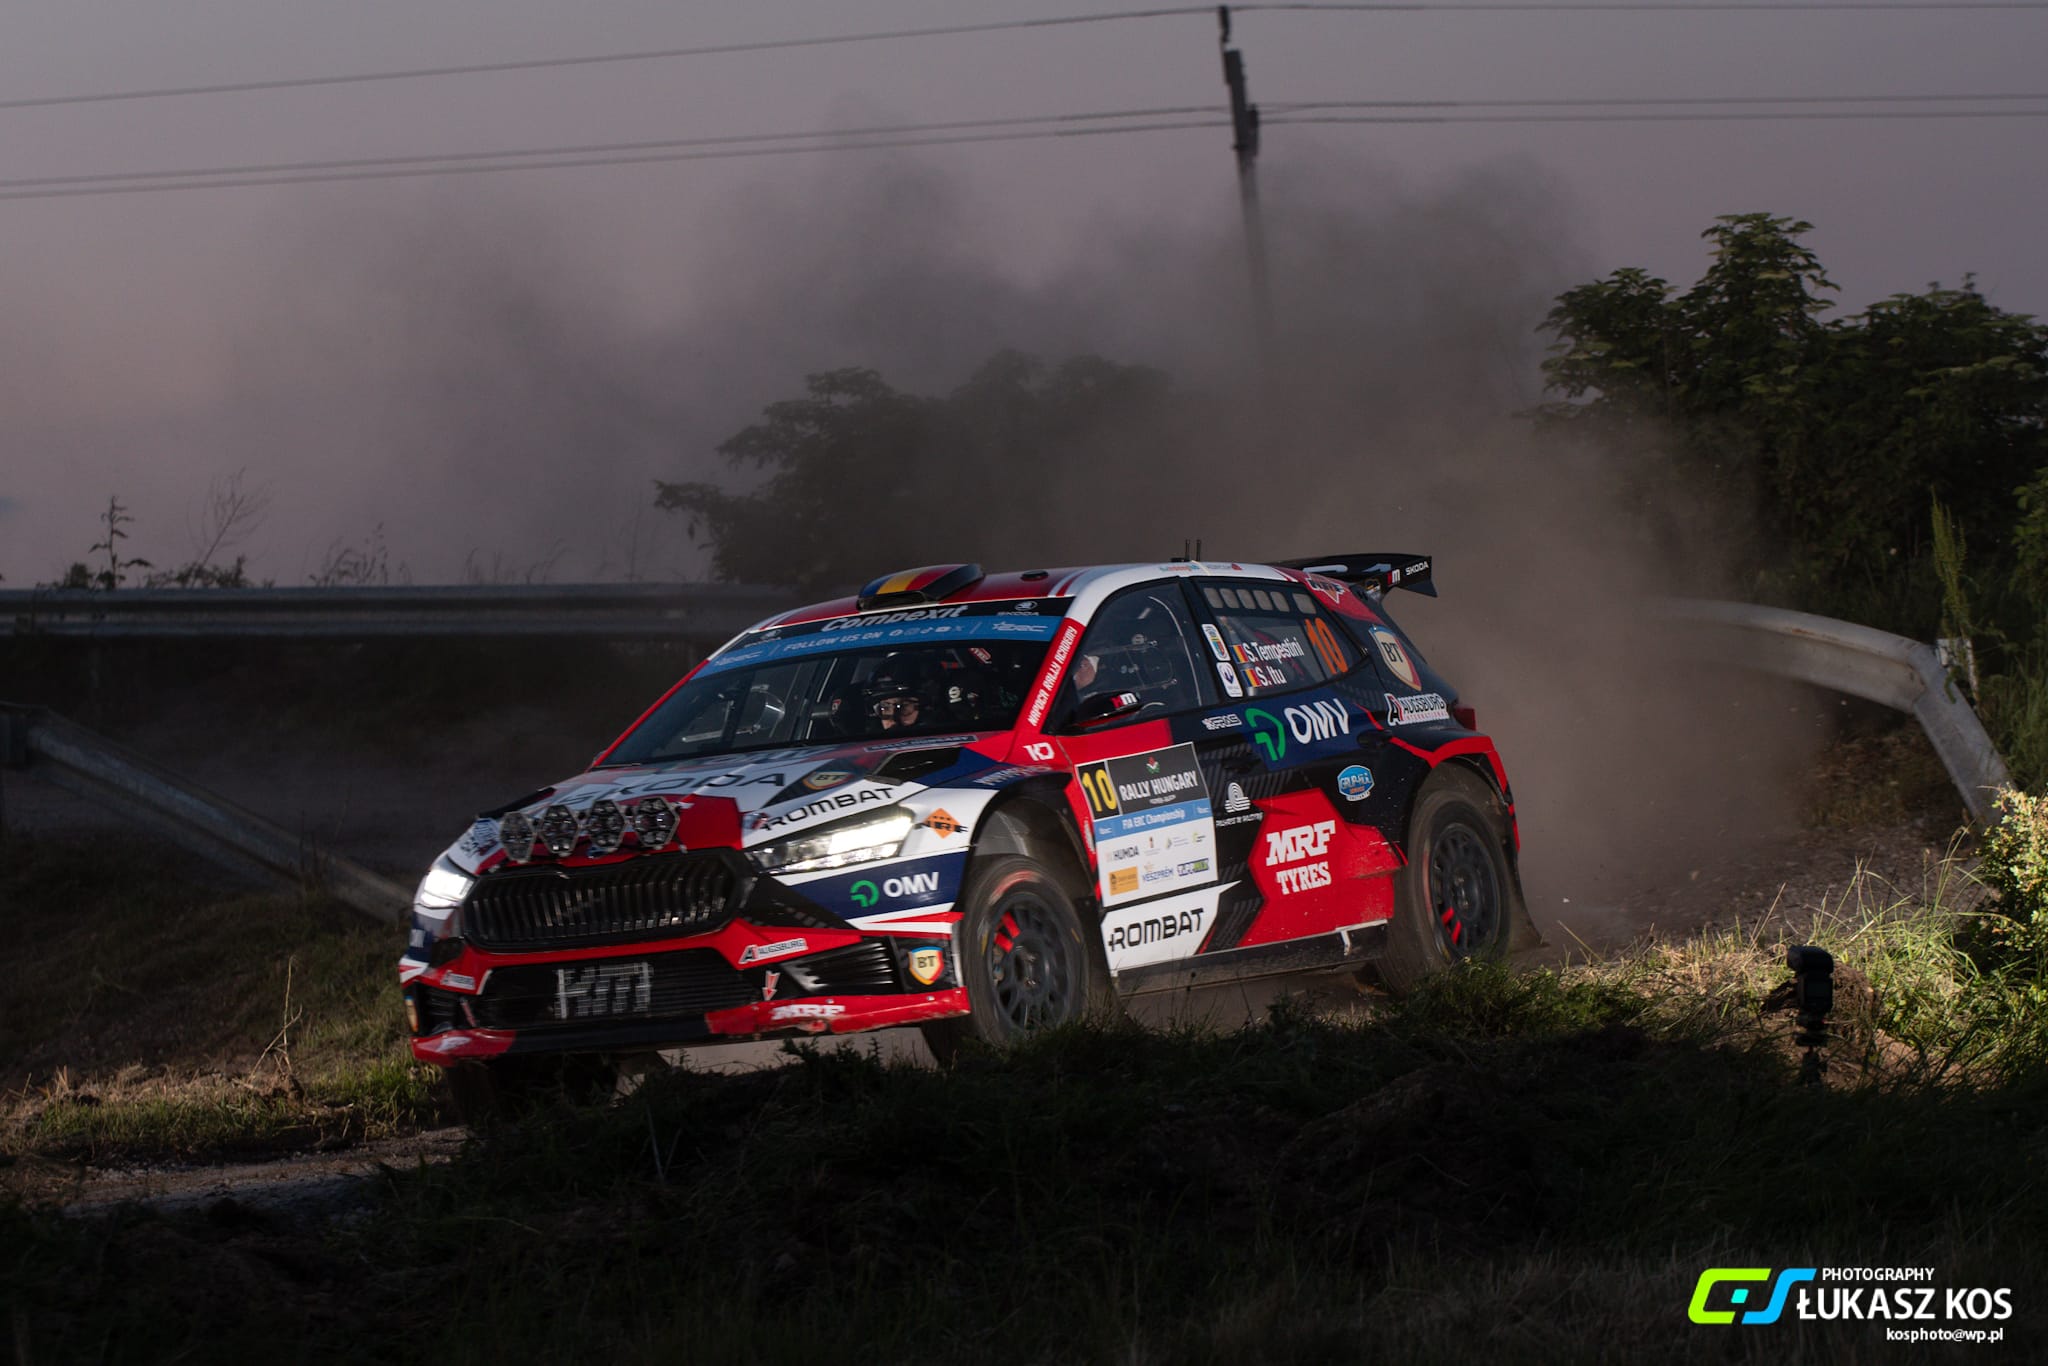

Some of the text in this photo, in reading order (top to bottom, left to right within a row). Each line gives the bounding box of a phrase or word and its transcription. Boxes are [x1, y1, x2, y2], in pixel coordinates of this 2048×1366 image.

[783, 637, 840, 652] FOLLOW
[840, 633, 861, 643] US
[862, 631, 883, 640] ON
[1305, 617, 1349, 675] 10
[1381, 642, 1403, 663] BT
[1043, 661, 1062, 691] RALLY
[1266, 665, 1287, 685] Itu
[1283, 698, 1350, 745] OMV
[1082, 769, 1118, 812] 10
[1118, 770, 1199, 801] RALLY HUNGARY
[765, 787, 893, 830] ROMBAT
[1265, 820, 1336, 866] MRF
[883, 872, 939, 897] OMV
[1276, 861, 1332, 895] TYRES
[1108, 907, 1204, 952] ROMBAT
[917, 955, 937, 969] BT
